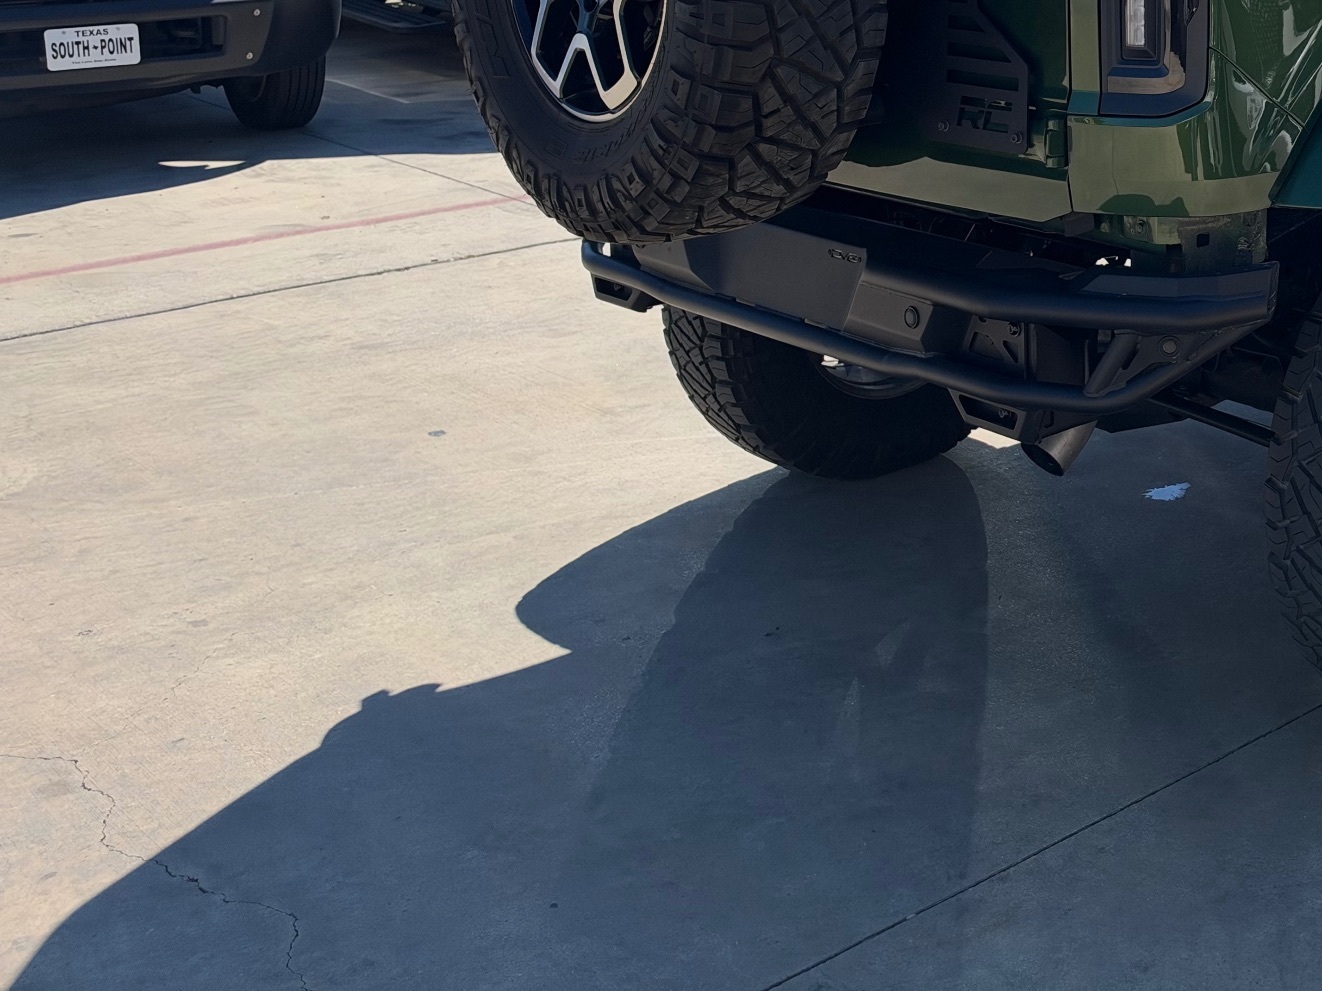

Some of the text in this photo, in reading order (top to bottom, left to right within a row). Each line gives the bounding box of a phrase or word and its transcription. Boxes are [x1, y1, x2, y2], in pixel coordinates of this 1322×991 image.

[74, 28, 109, 37] TEXAS
[51, 37, 134, 59] SOUTH POINT
